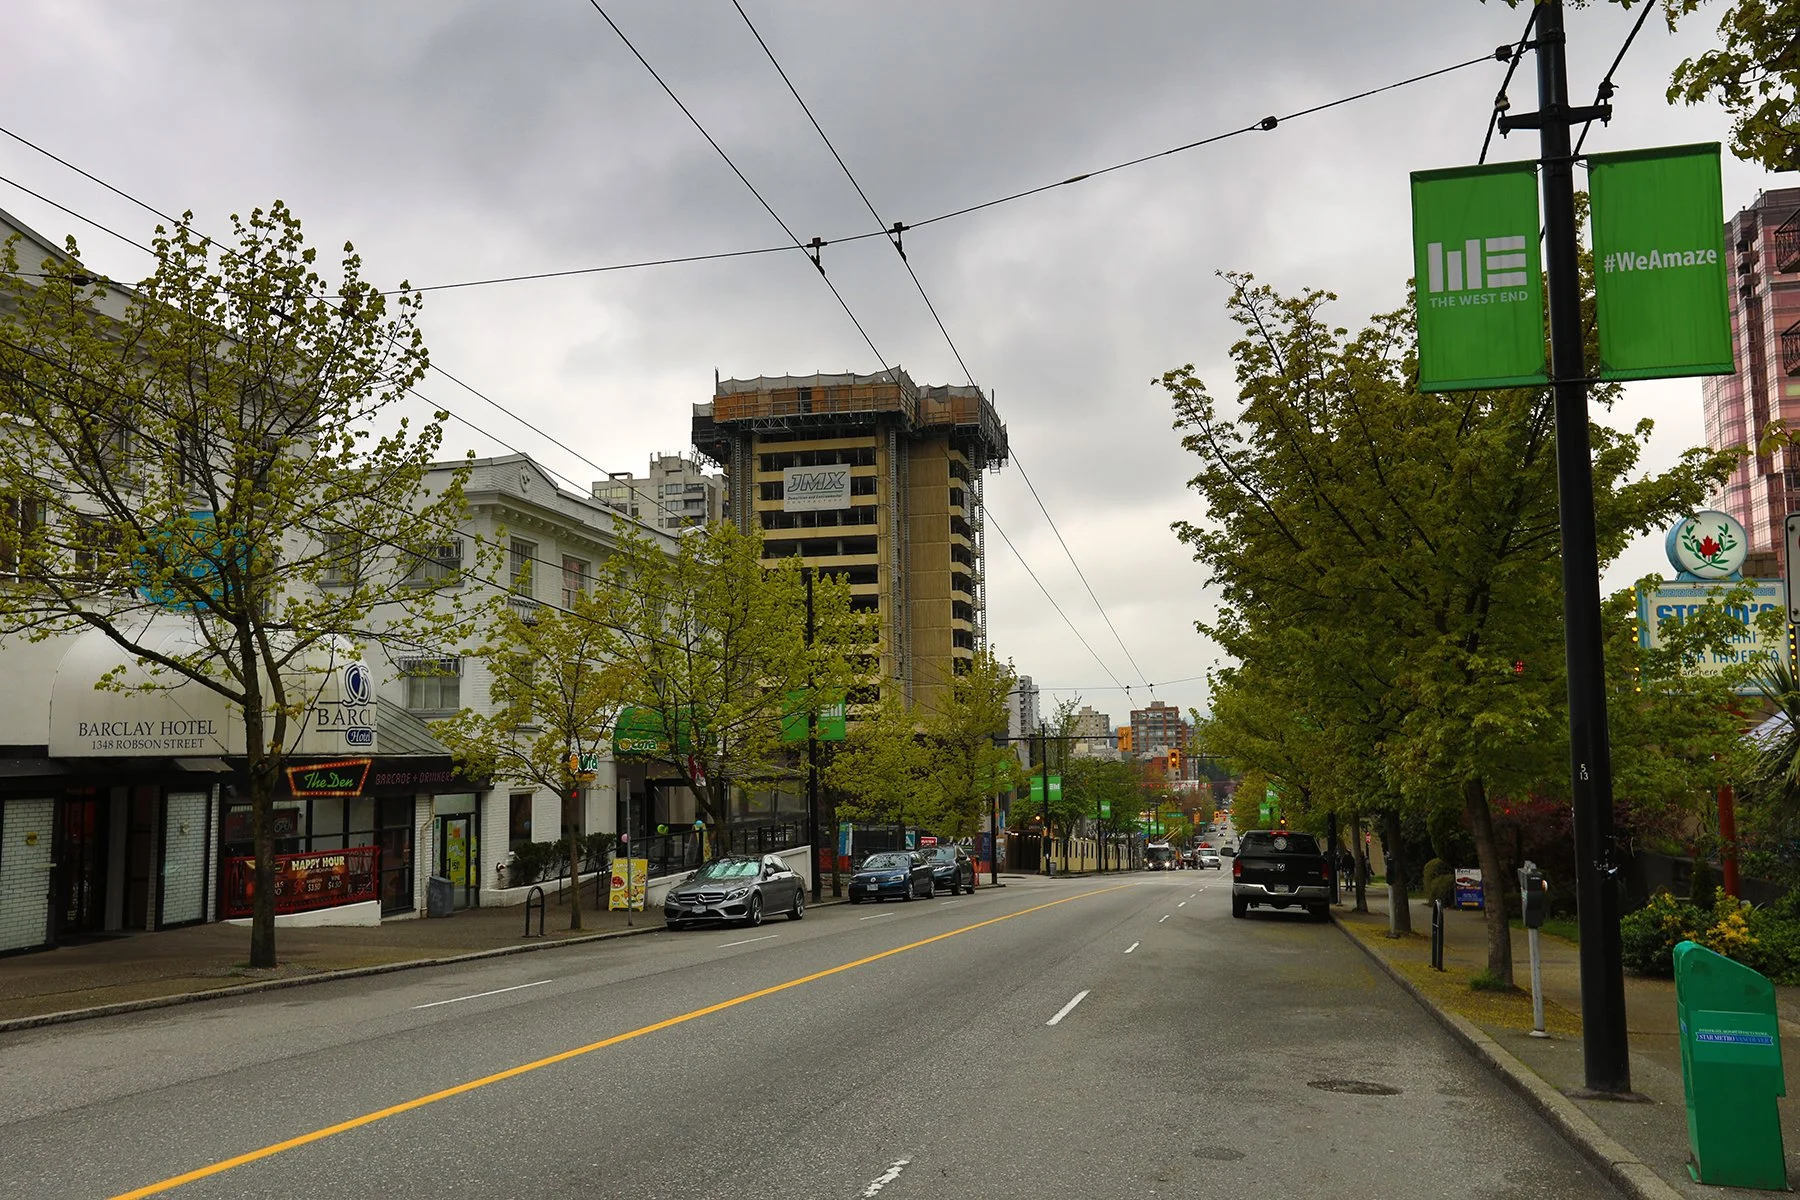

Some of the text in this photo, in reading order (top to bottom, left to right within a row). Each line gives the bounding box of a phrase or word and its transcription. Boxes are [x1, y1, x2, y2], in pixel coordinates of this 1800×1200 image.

[1604, 248, 1718, 274] #WeAmaze
[1429, 290, 1529, 309] THE WEST END
[787, 471, 846, 492] JMX
[1698, 667, 1719, 676] here
[317, 708, 377, 727] BARCL
[79, 720, 217, 737] BARCLAY HOTEL
[350, 731, 371, 742] Hotel
[92, 738, 205, 750] 1348 ROBSON STREET
[1579, 771, 1589, 781] 13
[1580, 763, 1587, 773] 5
[304, 771, 354, 789] The Den
[291, 857, 321, 871] HAPPY
[322, 855, 346, 867] HOUR
